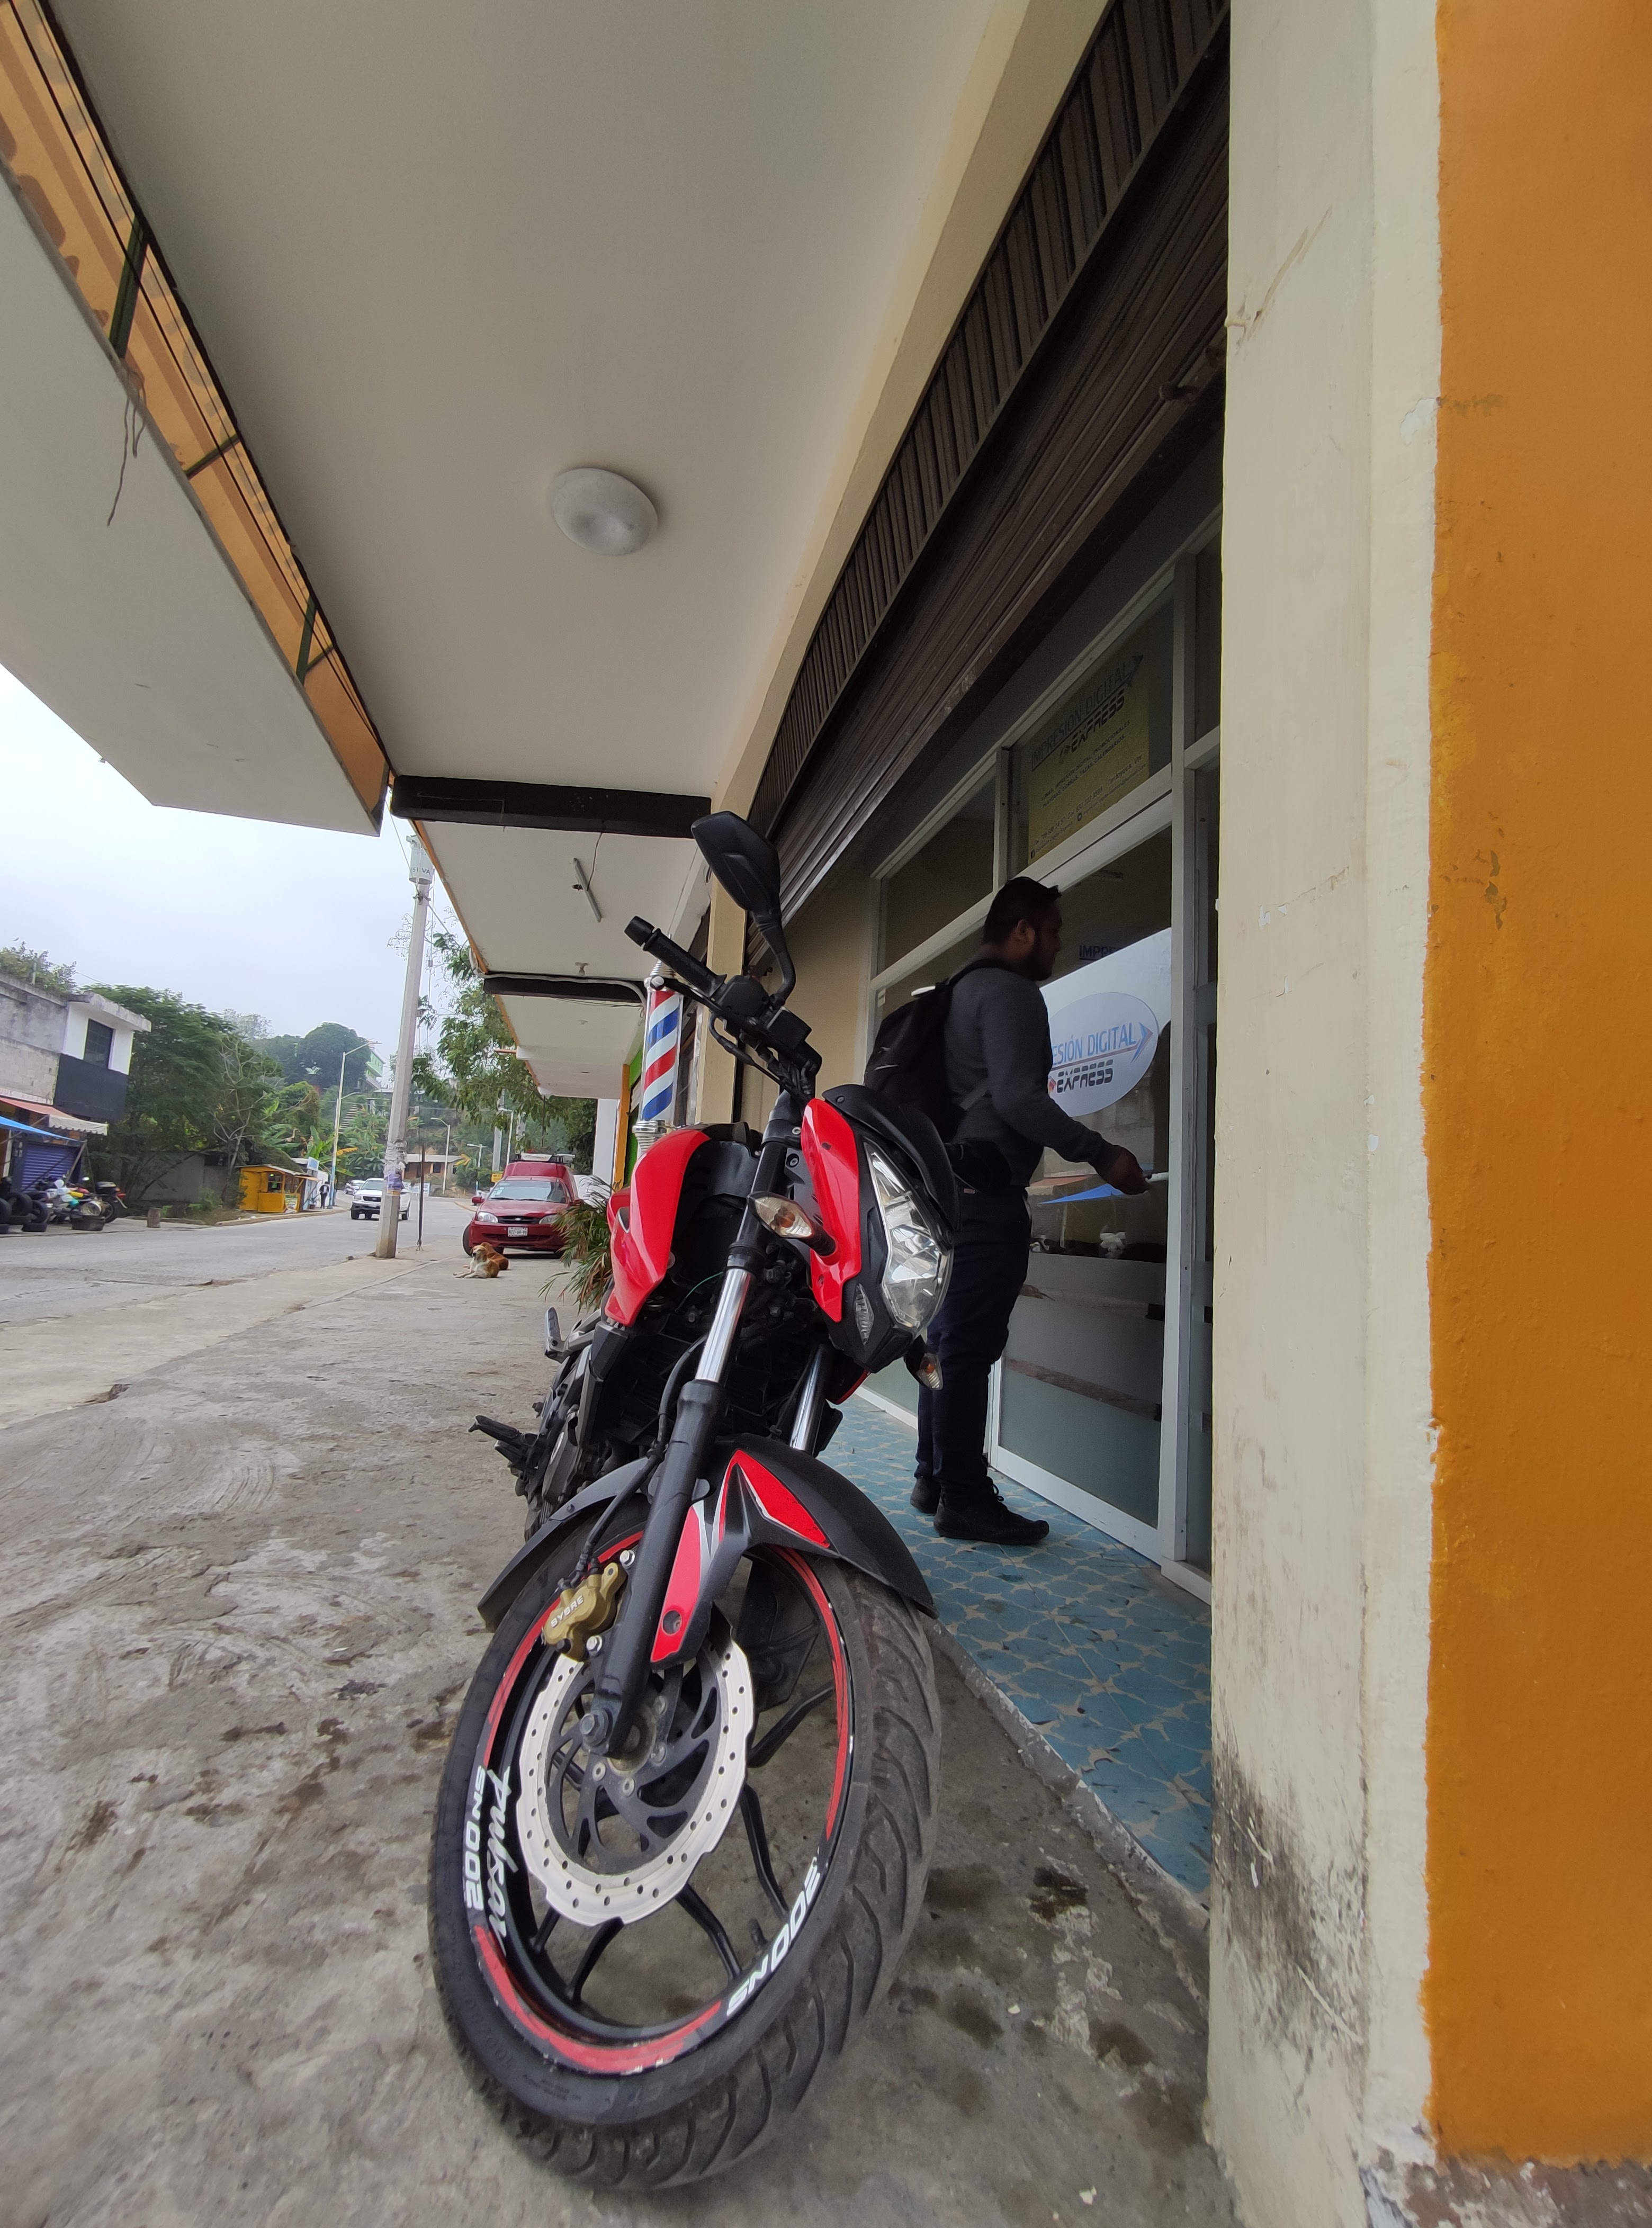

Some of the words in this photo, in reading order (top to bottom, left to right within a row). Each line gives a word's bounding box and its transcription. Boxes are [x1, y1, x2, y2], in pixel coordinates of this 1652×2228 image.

[1085, 661, 1129, 713] DIGITAL
[1071, 688, 1124, 753] EXPRESS
[1088, 1022, 1137, 1056] DIGITAL
[1057, 1059, 1114, 1093] EXPRESS
[551, 1595, 584, 1628] BYBRE
